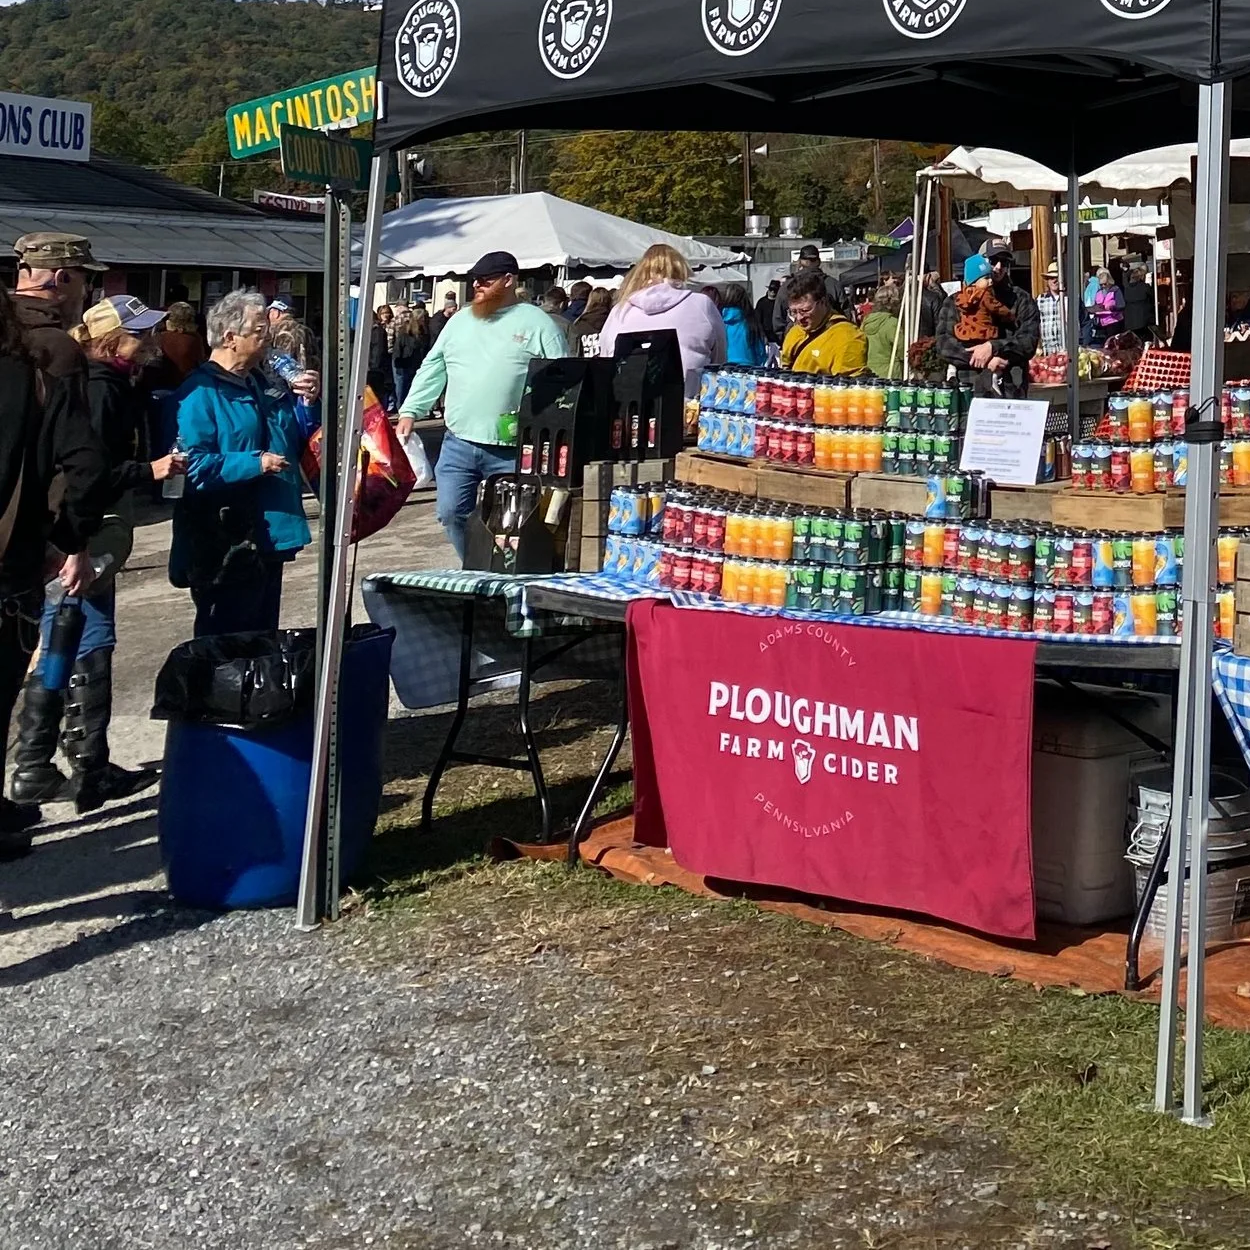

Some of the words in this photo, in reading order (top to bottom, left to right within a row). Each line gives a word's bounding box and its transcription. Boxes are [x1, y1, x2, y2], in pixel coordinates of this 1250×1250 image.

[401, 1, 455, 45] PLOUGHMAN
[708, 6, 735, 46] FARM
[739, 0, 774, 45] CIDER
[400, 52, 421, 88] FARM
[422, 45, 453, 88] CIDER
[545, 32, 568, 70] FARM
[570, 24, 603, 68] CIDER
[38, 108, 85, 150] CLUB
[233, 75, 375, 150] MACINTOSH
[286, 132, 362, 181] COURTLAND
[759, 623, 803, 653] ADAMS
[806, 625, 856, 668] COUNTY
[707, 681, 920, 752] PLOUGHMAN
[719, 732, 784, 761] FARM
[823, 752, 899, 785] CIDER
[754, 792, 854, 839] PENNSYLVANIA
